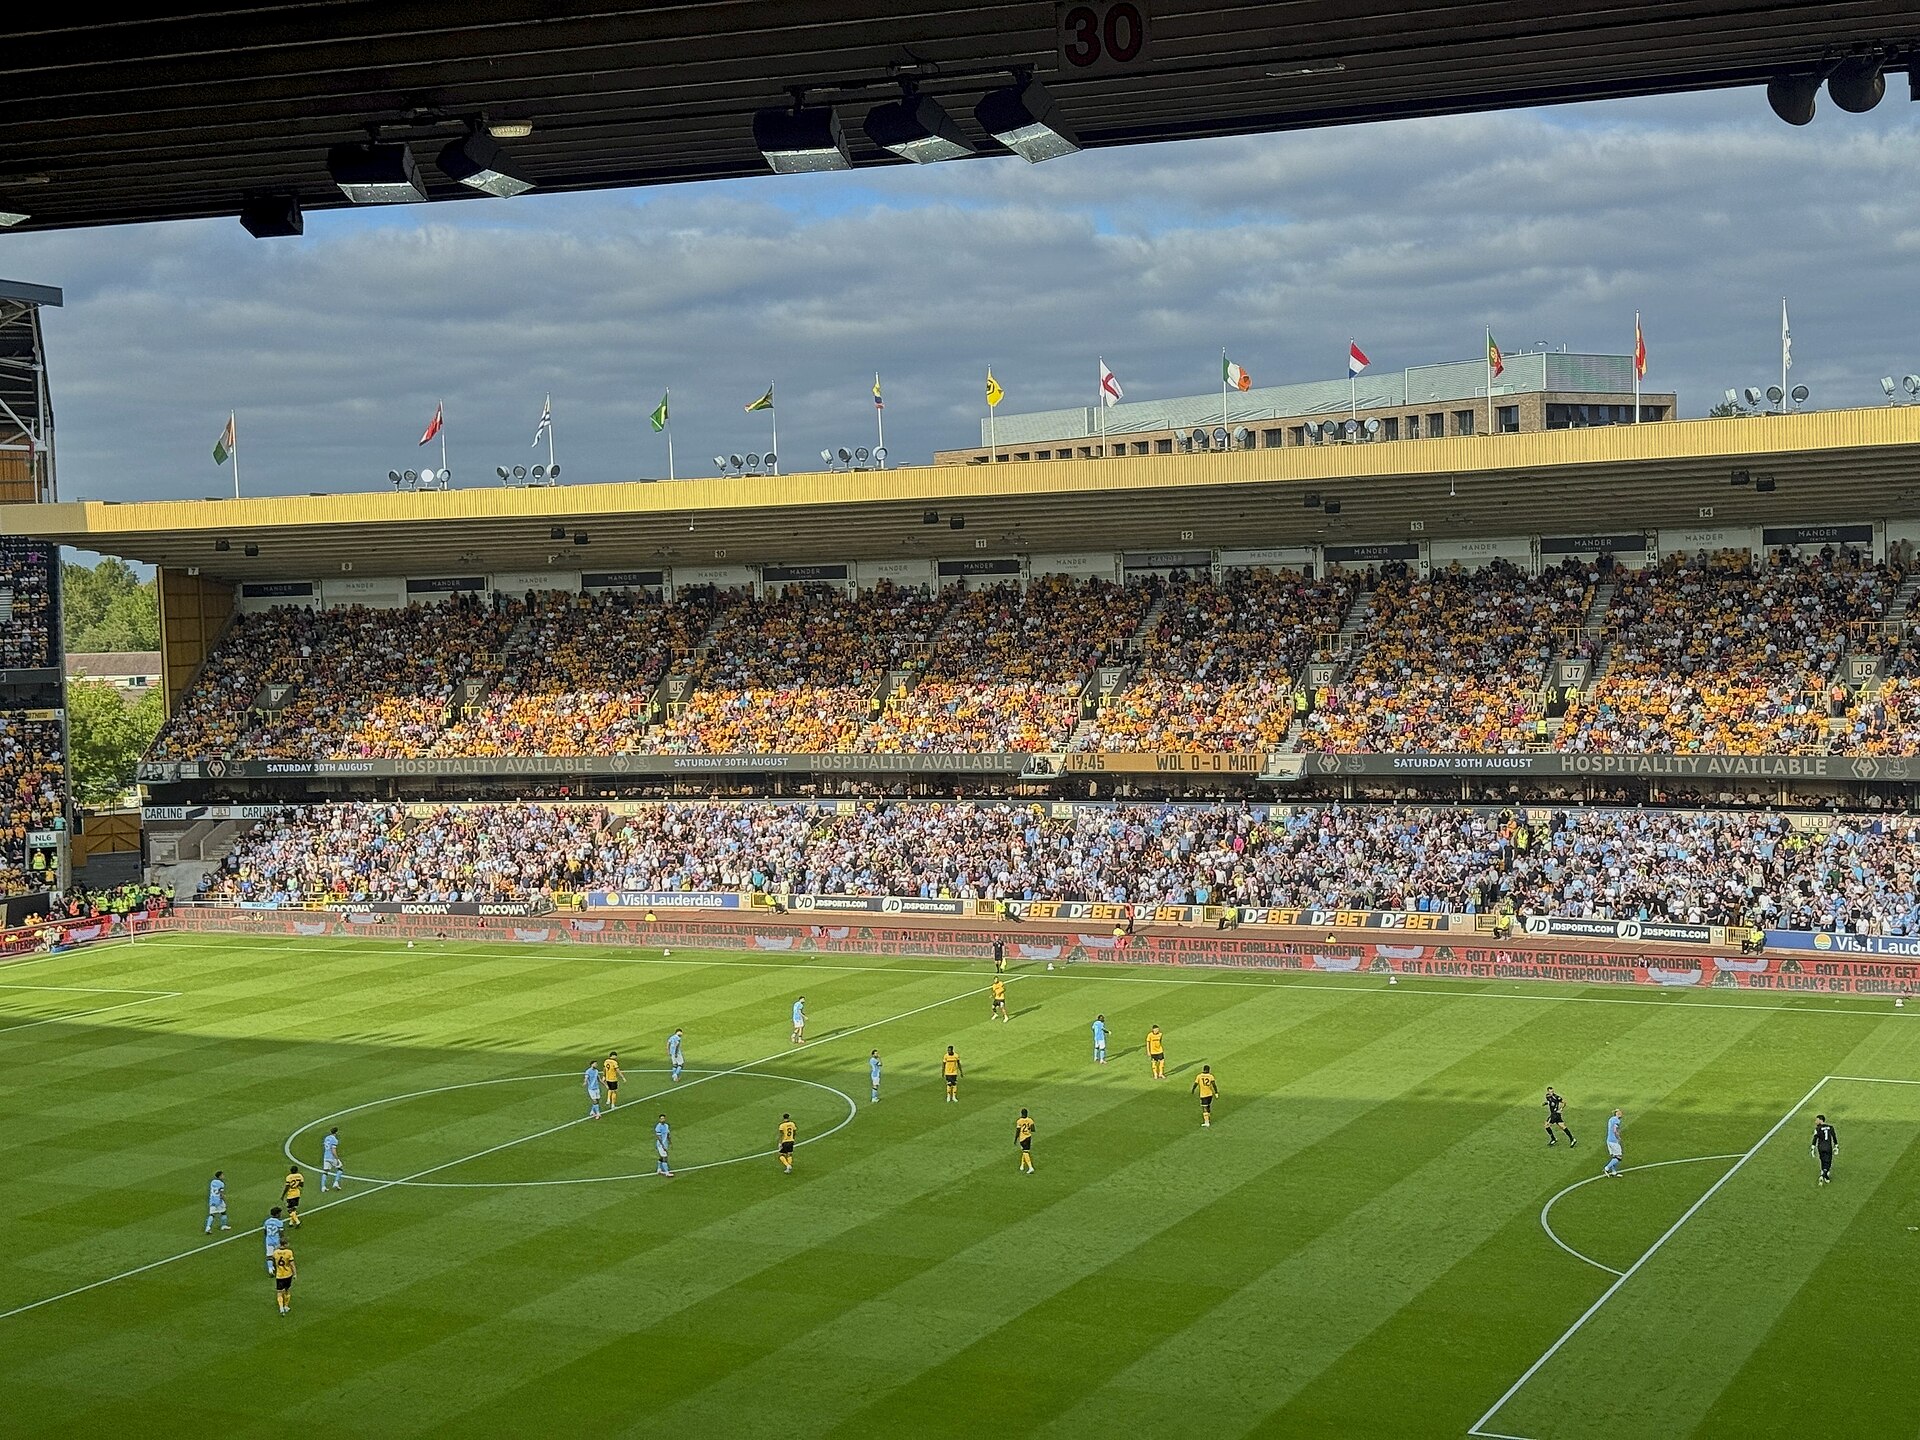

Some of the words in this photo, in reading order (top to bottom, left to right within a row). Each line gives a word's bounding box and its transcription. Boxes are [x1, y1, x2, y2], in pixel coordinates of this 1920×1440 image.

[1064, 2, 1143, 67] 30
[1701, 508, 1712, 517] 14
[1412, 521, 1422, 529] 13
[1685, 534, 1724, 542] MANDER
[1798, 529, 1838, 537] MANDER
[1575, 539, 1612, 547] MANDER
[1354, 547, 1388, 555] MANDER
[1646, 552, 1656, 561] 14
[1419, 560, 1428, 569] 13
[1566, 667, 1580, 678] J7
[1857, 664, 1872, 675] J8
[1105, 674, 1117, 685] J5
[1316, 671, 1329, 682] J6
[672, 681, 684, 692] J3
[267, 763, 311, 773] SATURDAY
[314, 762, 335, 772] 30TH
[338, 762, 373, 771] AUGUST
[394, 760, 499, 773] HOSPITALITY
[505, 758, 593, 772] AVAILABLE
[674, 759, 722, 767] SATURDAY
[724, 758, 747, 767] 30TH
[750, 757, 788, 766] AUGUST
[810, 755, 915, 769] HOSPITALITY
[921, 755, 1012, 769] AVAILABLE
[1071, 755, 1105, 770] 17:45
[1156, 755, 1184, 770] WOL
[1229, 755, 1257, 770] MAN
[1393, 758, 1451, 768] SATURDAY
[1454, 758, 1482, 768] 30TH
[1486, 758, 1533, 768] AUGUST
[1561, 755, 1700, 773] HOSPITALITY
[1707, 758, 1827, 775] AVAILABLE
[144, 807, 182, 819] CARLING
[1273, 807, 1288, 816] JL6
[1532, 810, 1547, 819] JL7
[1805, 818, 1823, 827] JL8
[35, 834, 52, 842] NL6
[621, 894, 650, 906] Visit
[652, 894, 722, 907] Lauderdale
[797, 897, 812, 908] JD
[884, 898, 899, 909] JD
[1244, 909, 1302, 924] DEBET
[1312, 911, 1371, 927] DEBET
[1381, 913, 1442, 930] DEBET
[1529, 919, 1547, 932] JD
[1551, 923, 1614, 934] JDSPORTS.COM
[1620, 923, 1638, 937] JD
[1642, 927, 1708, 939] JDSPORTS.COM
[882, 931, 898, 941] GOT
[910, 932, 934, 941] LEAK?
[937, 932, 952, 942] GET
[826, 941, 841, 951] GOT
[852, 942, 878, 952] LEAK?
[881, 943, 896, 952] GET
[1159, 939, 1177, 949] GOT
[1180, 940, 1187, 950] A
[1189, 940, 1218, 952] LEAK?
[1220, 942, 1238, 952] GET
[1241, 942, 1280, 954] GORILLA
[1097, 949, 1116, 960] GOT
[1119, 951, 1126, 961] A
[1128, 951, 1155, 962] LEAK?
[1158, 952, 1176, 963] GET
[1178, 953, 1217, 964] GORILLA
[1220, 954, 1302, 967] WATERPROOFING
[1466, 950, 1484, 961] GOT
[1488, 951, 1496, 962] A
[1508, 952, 1532, 963] AK?
[1536, 952, 1555, 964] GET
[1559, 954, 1604, 967] GORILLA
[1608, 955, 1701, 970] WATEPROOFING
[1402, 961, 1421, 973] GOT
[1425, 962, 1433, 973] A
[1435, 962, 1467, 974] LEAK?
[1471, 964, 1489, 976] GET
[1494, 965, 1539, 978] GORILLA
[1542, 966, 1635, 982] WATERPROOFING
[1816, 963, 1839, 975] GOT
[1842, 964, 1851, 975] A
[1853, 965, 1891, 978] LEAK?
[1895, 966, 1918, 978] GET
[1750, 974, 1773, 987] GOT
[1776, 975, 1785, 988] A
[1787, 975, 1825, 989] LEAK?
[1829, 977, 1852, 990] GET
[1201, 1078, 1209, 1086] 12
[1824, 1130, 1828, 1141] 1
[290, 1180, 300, 1189] 27
[278, 1256, 284, 1267] 6
